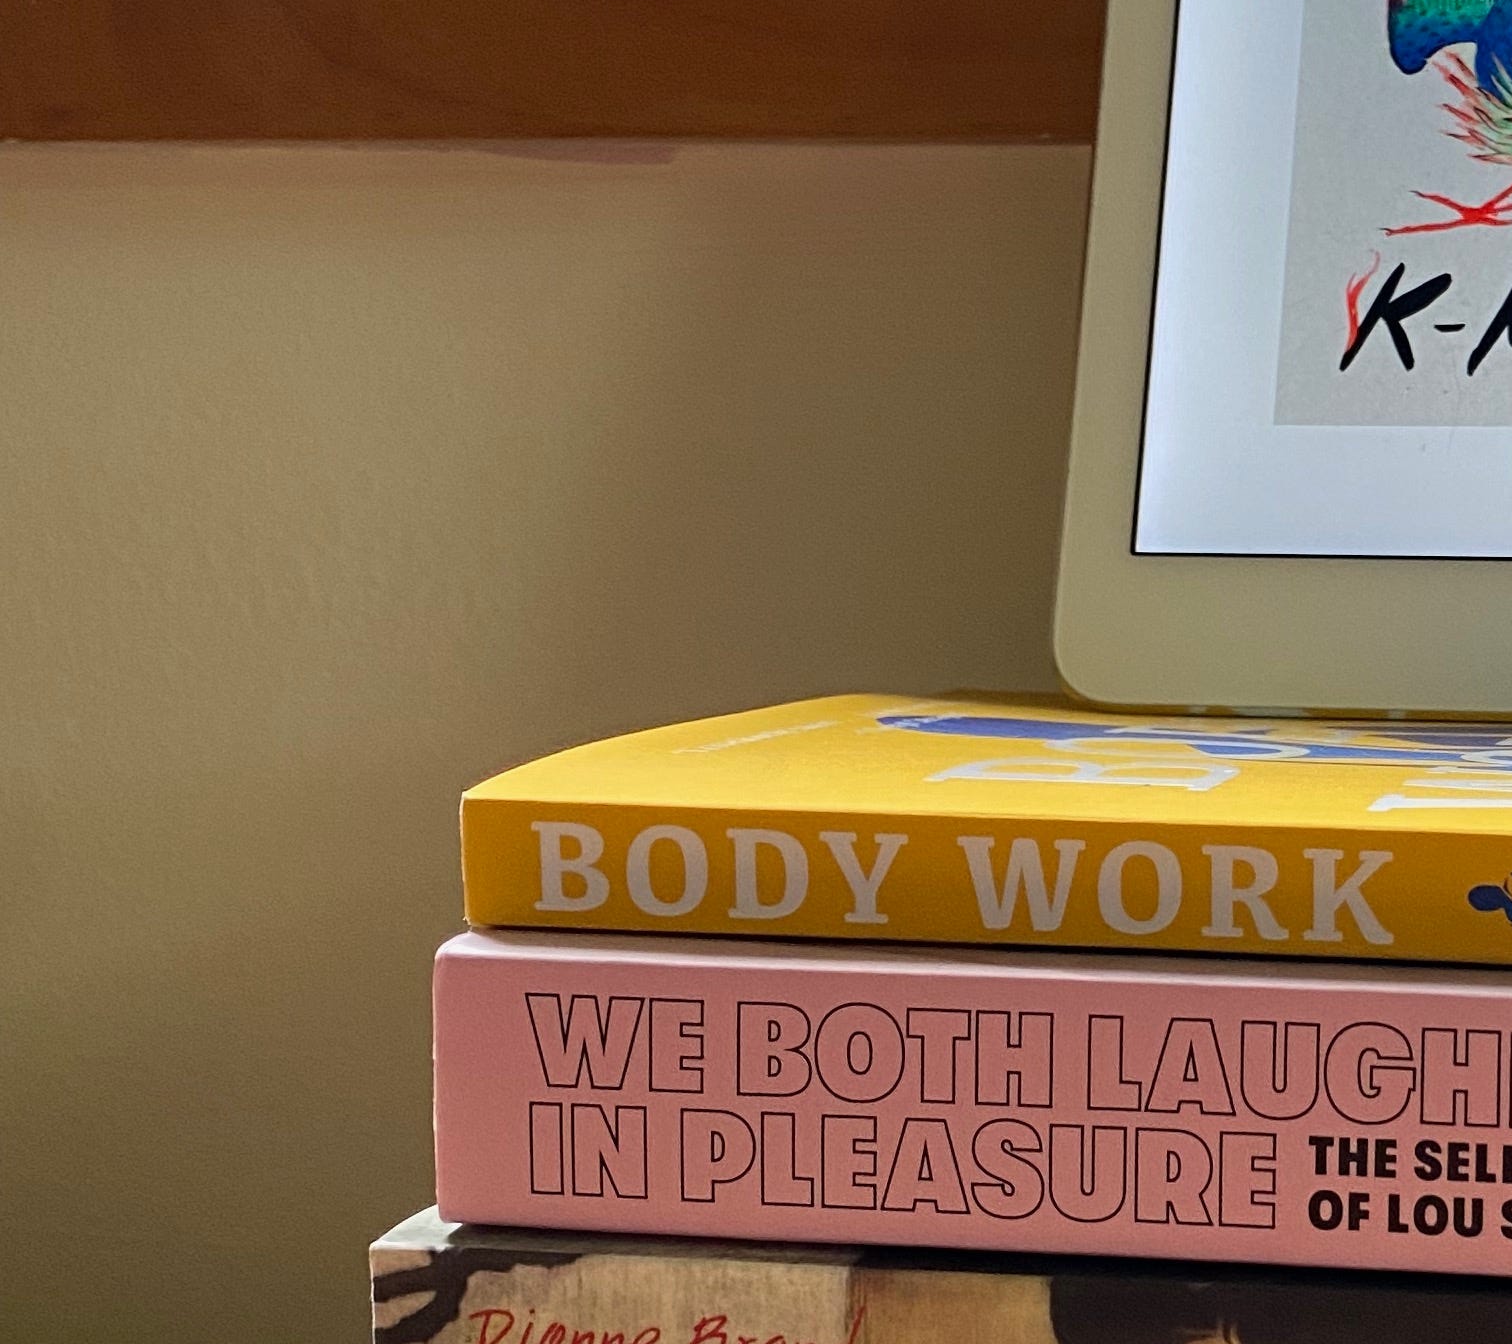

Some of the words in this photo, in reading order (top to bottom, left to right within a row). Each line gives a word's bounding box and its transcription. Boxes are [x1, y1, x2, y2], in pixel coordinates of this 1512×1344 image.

[530, 820, 909, 925] BODY
[957, 834, 1395, 946] WORK
[525, 992, 704, 1094] WE
[737, 1000, 1054, 1109] BOTH
[530, 1100, 648, 1200] IN
[681, 1107, 1277, 1229] PLEASURE
[1308, 1189, 1370, 1232] OF
[1387, 1193, 1484, 1238] LOU
[1309, 1135, 1398, 1179] THE
